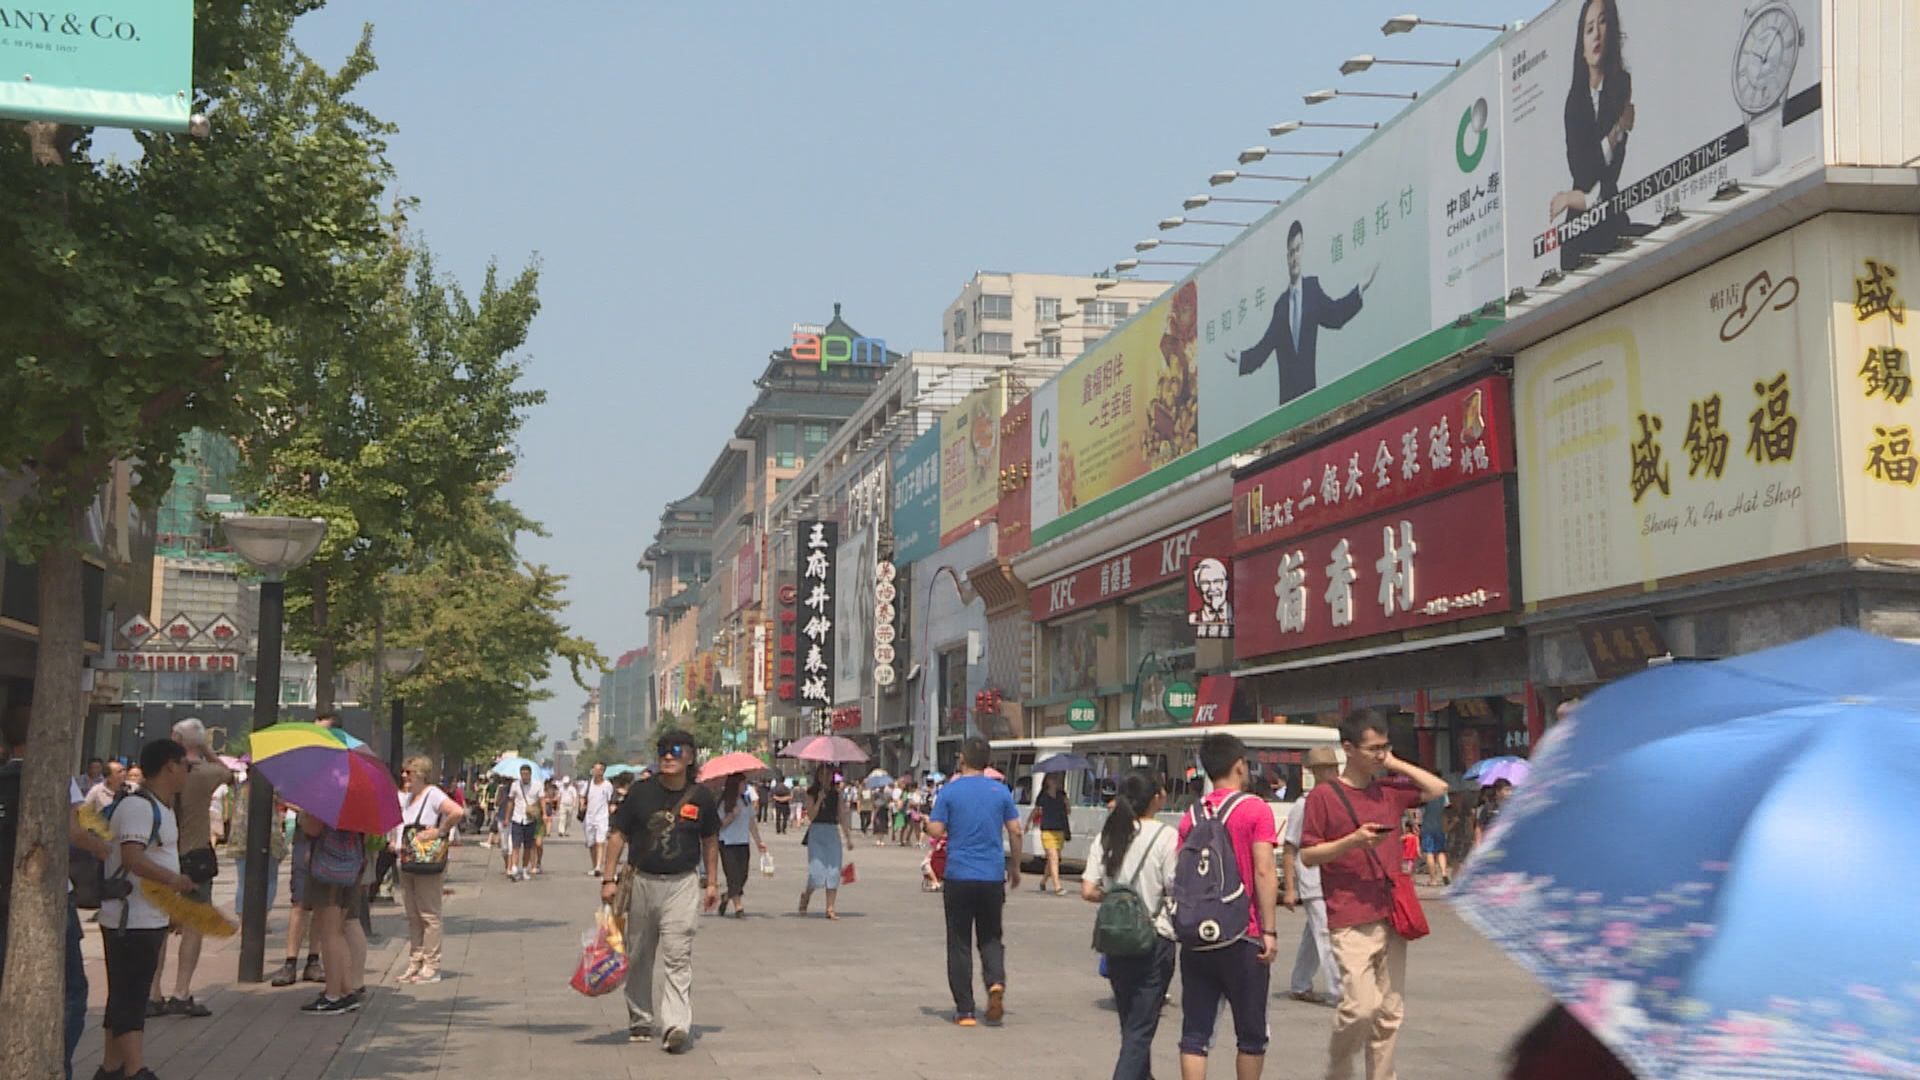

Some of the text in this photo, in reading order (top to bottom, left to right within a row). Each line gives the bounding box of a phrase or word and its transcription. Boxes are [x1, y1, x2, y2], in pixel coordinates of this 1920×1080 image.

[61, 12, 84, 35] &
[1446, 172, 1500, 219] 中国人寿
[1558, 202, 1609, 243] TISSOT
[1612, 188, 1639, 215] THIS
[1641, 179, 1652, 200] IS
[1654, 155, 1692, 192] YOUR
[1694, 137, 1728, 173] TIME
[1331, 184, 1414, 264] 值得托付
[1447, 196, 1500, 237] CHINA LIFE
[791, 333, 887, 372] apm
[1728, 490, 1758, 517] Hat
[1763, 481, 1802, 508] Shop
[1049, 575, 1078, 612] KFC
[1100, 554, 1132, 597] 肯德基
[1195, 704, 1218, 723] KFC
